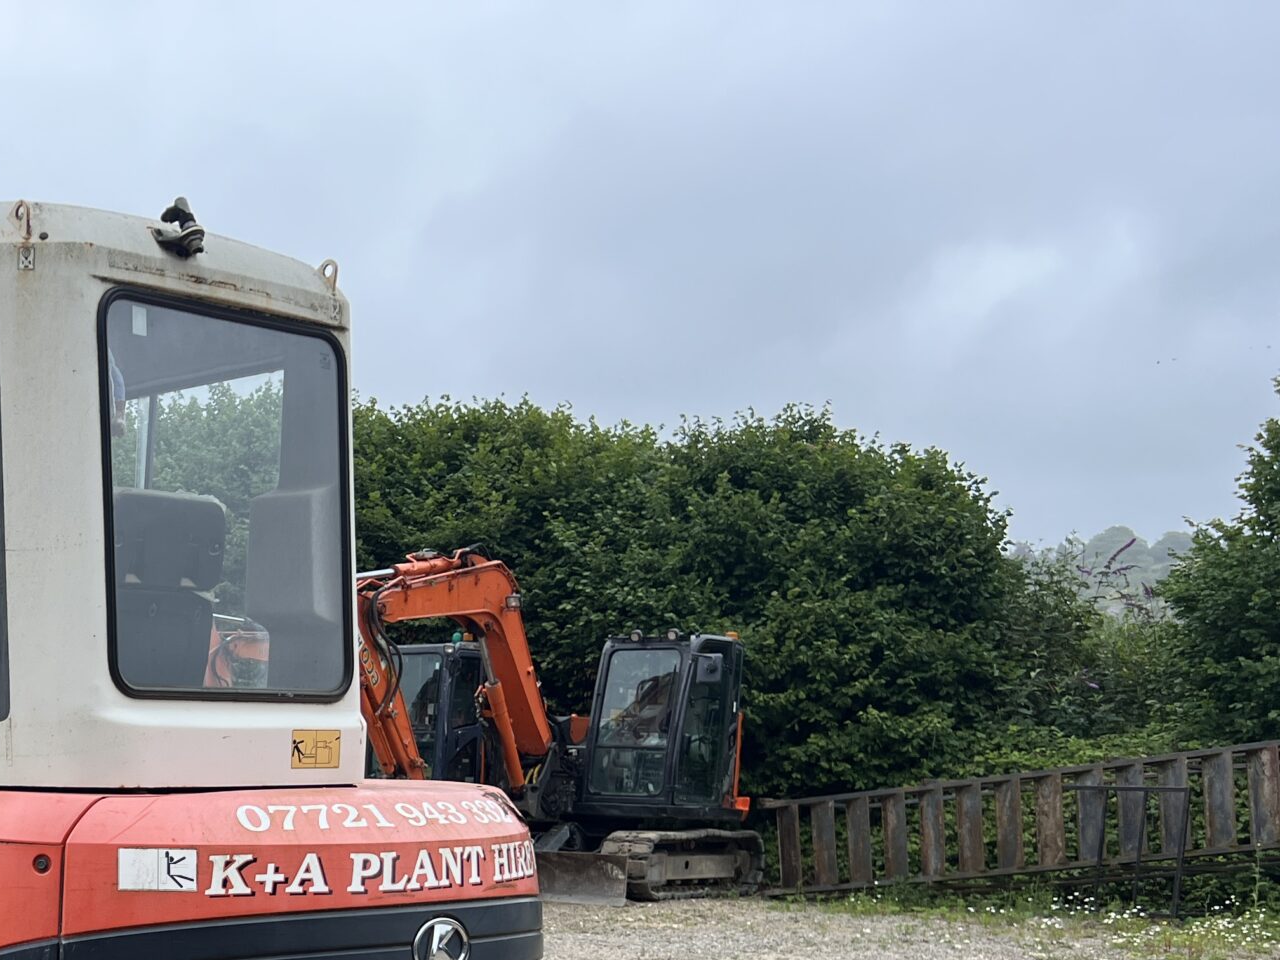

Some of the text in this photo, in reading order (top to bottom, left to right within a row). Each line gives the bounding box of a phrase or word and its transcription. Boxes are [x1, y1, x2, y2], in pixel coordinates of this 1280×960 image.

[236, 799, 513, 832] 07721 943 332
[205, 840, 536, 898] K+A PLANT HIRE
